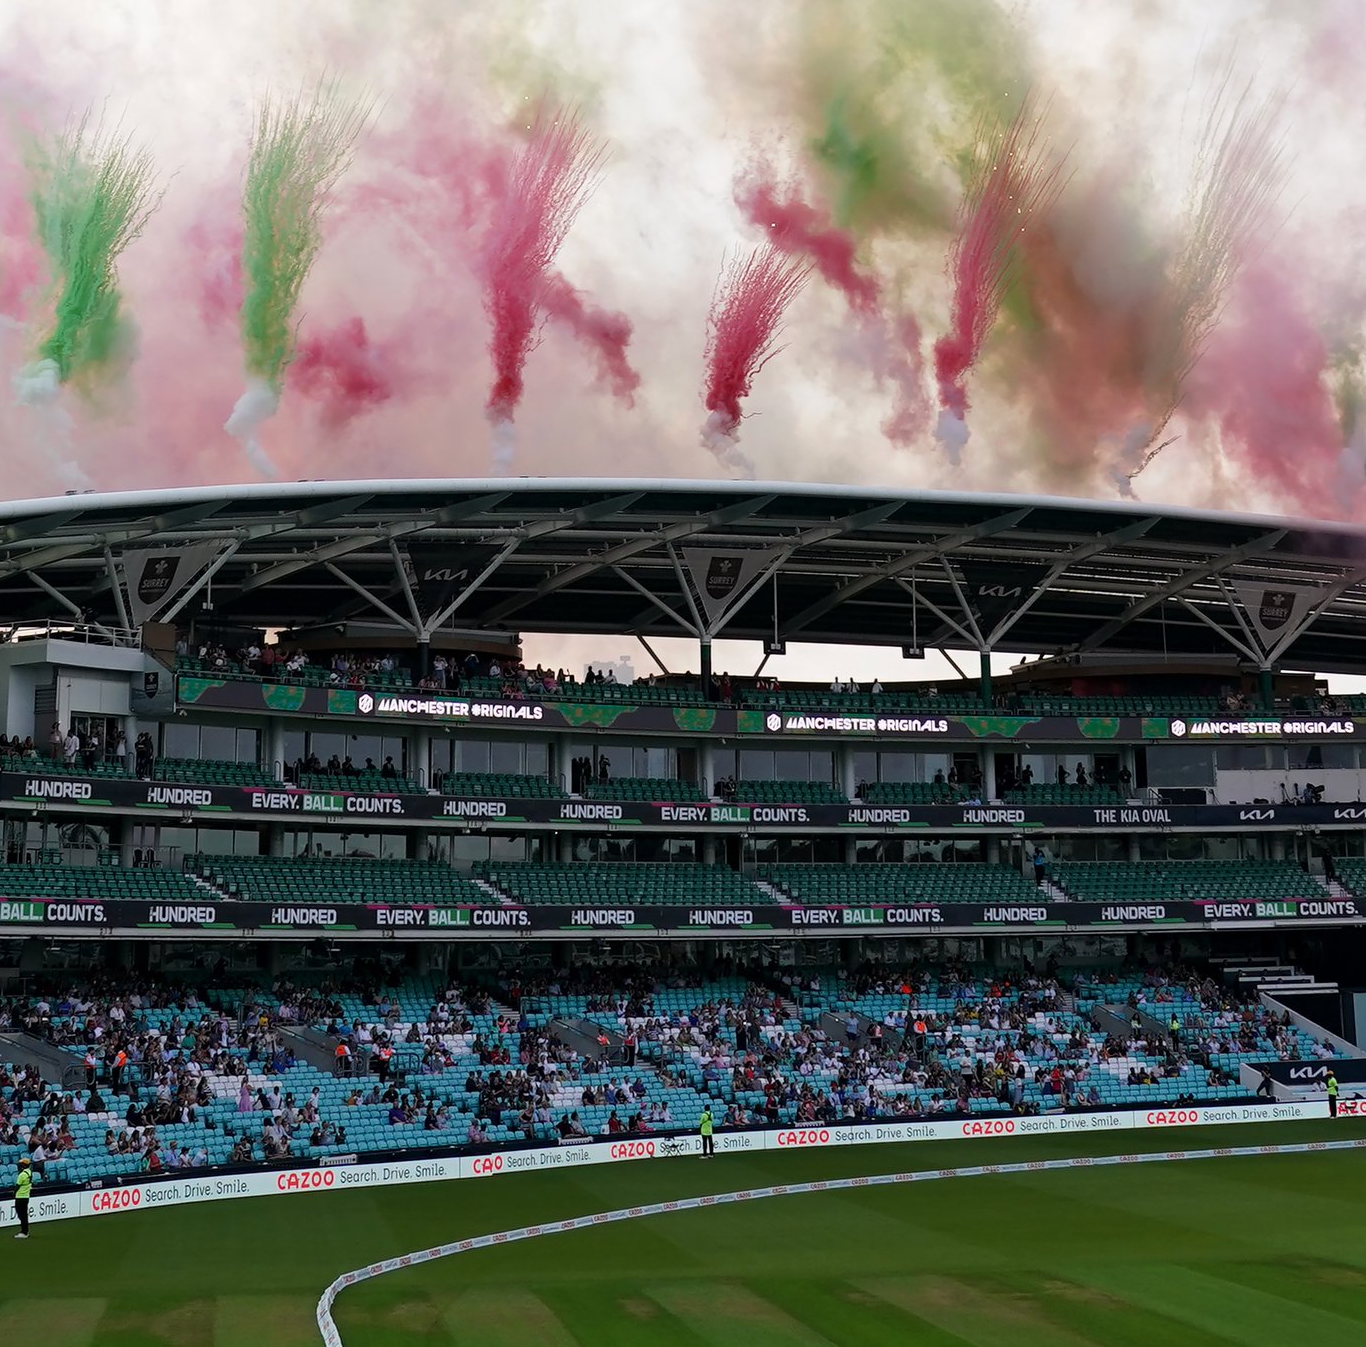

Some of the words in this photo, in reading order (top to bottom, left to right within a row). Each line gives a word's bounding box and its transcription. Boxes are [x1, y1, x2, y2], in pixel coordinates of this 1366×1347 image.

[142, 578, 170, 588] SURREY
[378, 698, 469, 716] MANCHESTER
[786, 717, 875, 731] MANCHESTER
[1191, 723, 1281, 734] MANCHESTER
[25, 780, 92, 799] HUNDRED
[147, 787, 212, 806] HUNDRED
[252, 792, 300, 810] EVERY.
[303, 795, 343, 811] BALL.
[347, 796, 405, 814] COUNTS.
[443, 800, 506, 817] HUNDRED
[560, 803, 622, 819] HUNDRED
[661, 806, 708, 821] EVERY.
[710, 807, 750, 822] BALL.
[753, 808, 810, 823] COUNTS.
[848, 808, 910, 823] HUNDRED
[963, 809, 1025, 823] HUNDRED
[1093, 809, 1117, 823] THE
[1120, 809, 1140, 823] KIA
[1142, 809, 1171, 823] OVAL
[0, 903, 44, 921] BALL.
[47, 904, 107, 922] COUNTS.
[149, 905, 216, 923] HUNDRED
[271, 907, 338, 925] HUNDRED
[376, 908, 425, 925] EVERY.
[428, 909, 470, 925] BALL.
[473, 910, 531, 926] COUNTS.
[571, 909, 635, 925] HUNDRED
[689, 909, 753, 925] HUNDRED
[791, 909, 839, 924] EVERY.
[843, 908, 884, 924] BALL.
[887, 908, 944, 923] COUNTS.
[983, 907, 1047, 922] HUNDRED
[1101, 905, 1166, 920] HUNDRED
[1204, 903, 1253, 918] EVERY.
[1256, 902, 1297, 917] BALL.
[1299, 900, 1359, 916] COUNTS.
[1147, 1110, 1198, 1125] CAZOO
[1203, 1109, 1240, 1122] Search.
[1242, 1108, 1270, 1120] Drive.
[1272, 1106, 1303, 1118] Smile.
[963, 1120, 1015, 1136] CAZOO
[1020, 1118, 1058, 1131] Search.
[1060, 1117, 1089, 1130] Drive.
[1091, 1115, 1122, 1127] Smile.
[724, 1136, 753, 1149] Smile.
[777, 1129, 830, 1145] CAZOO
[835, 1128, 873, 1142] Search.
[876, 1127, 905, 1139] Drive.
[906, 1125, 937, 1137] Smile.
[507, 1153, 537, 1168] Search.
[540, 1150, 562, 1164] Drive.
[565, 1146, 591, 1161] Smile.
[277, 1170, 335, 1191] CAZOO
[340, 1169, 380, 1184] Search.
[383, 1167, 413, 1181] Drive.
[416, 1164, 447, 1177] Smile.
[92, 1188, 141, 1211] CAZOO
[145, 1186, 182, 1203] Search.
[184, 1183, 214, 1198] Drive.
[216, 1180, 250, 1195] Smile.
[39, 1199, 68, 1218] Smile.
